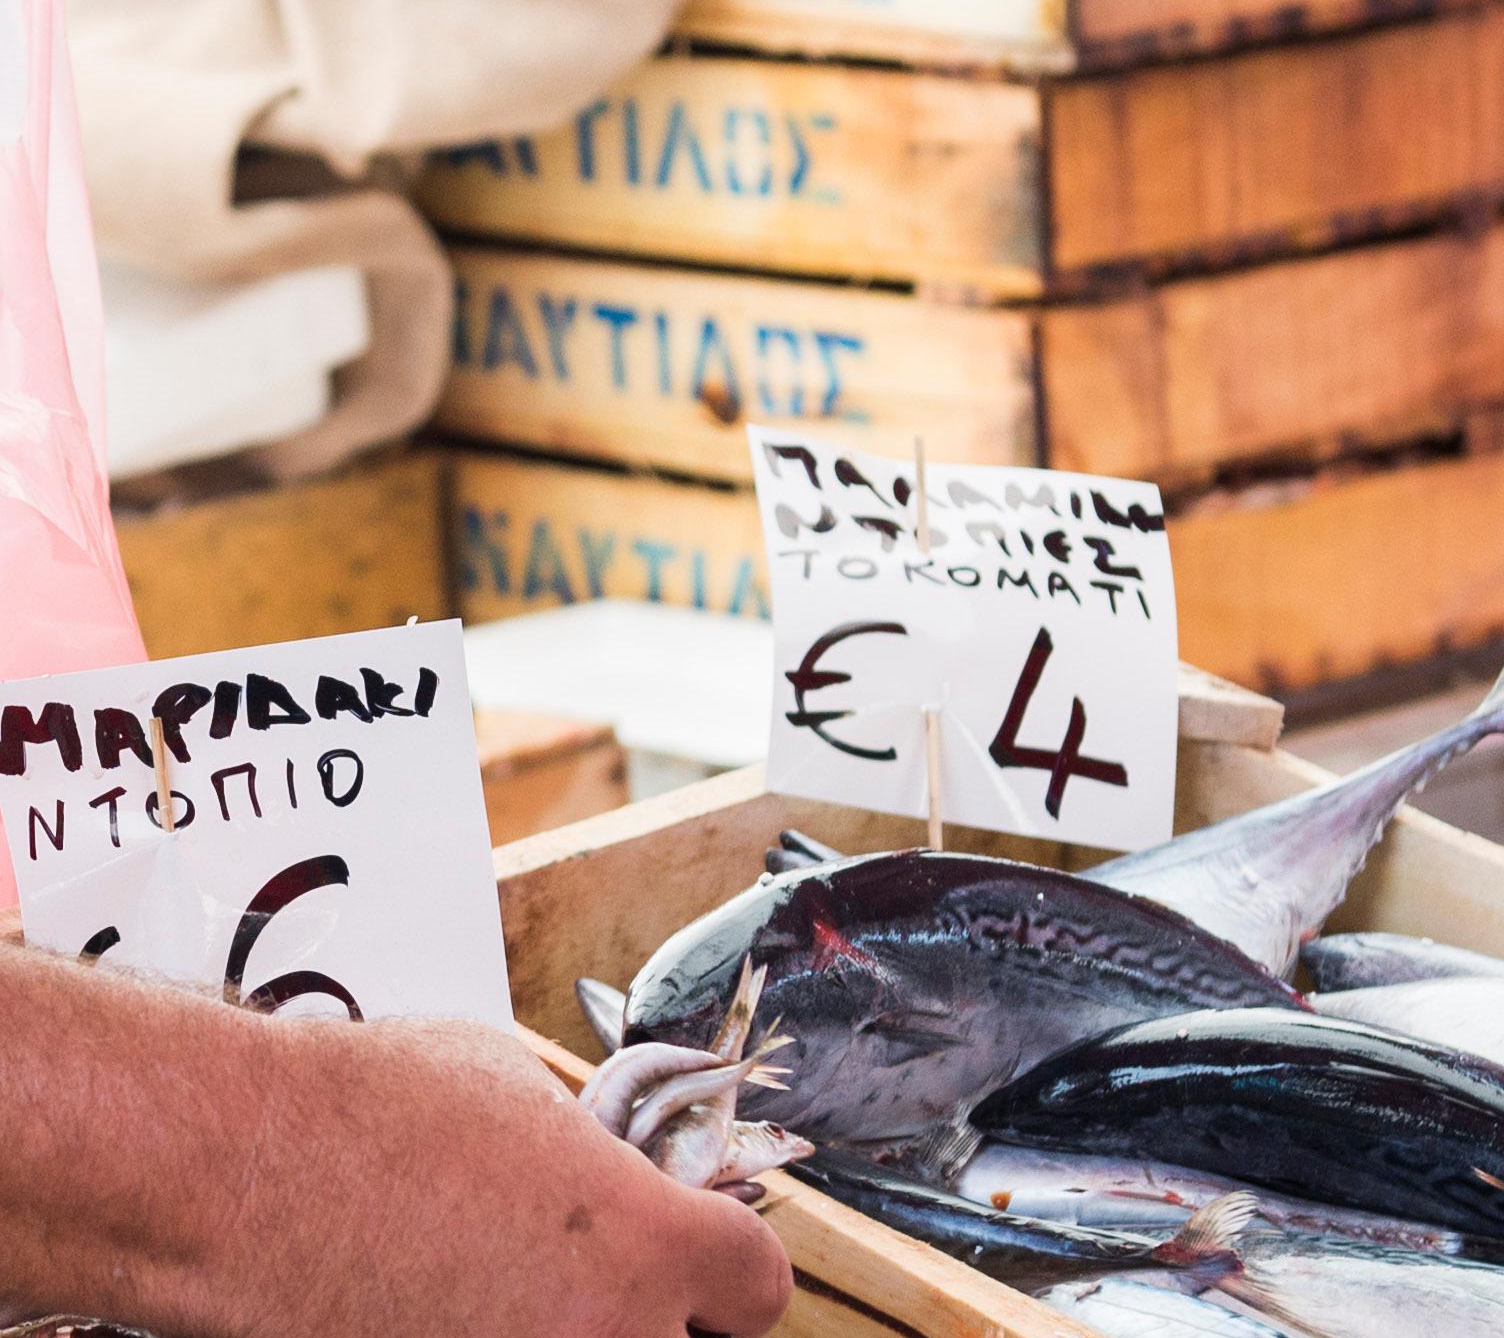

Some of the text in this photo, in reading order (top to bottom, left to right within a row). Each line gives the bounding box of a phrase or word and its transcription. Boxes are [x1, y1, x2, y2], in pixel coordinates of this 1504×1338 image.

[461, 506, 772, 622] ΝΑΥΤΙΛ
[784, 621, 1129, 822] € 4
[27, 748, 365, 861] ΝΤΟΠΙΟ
